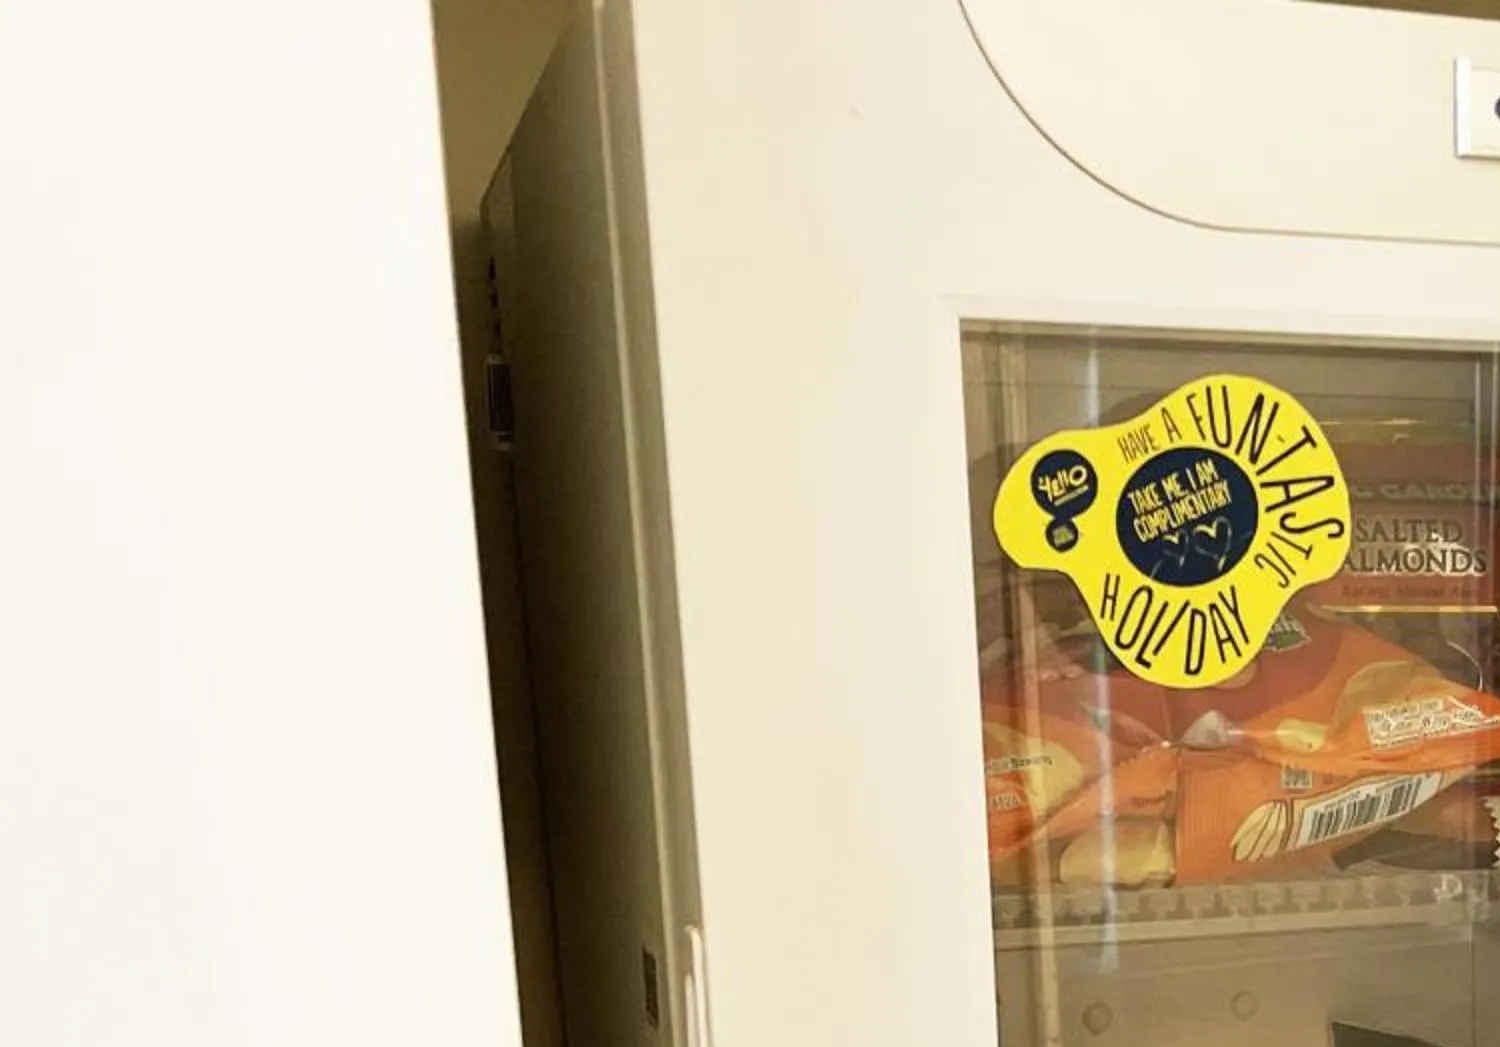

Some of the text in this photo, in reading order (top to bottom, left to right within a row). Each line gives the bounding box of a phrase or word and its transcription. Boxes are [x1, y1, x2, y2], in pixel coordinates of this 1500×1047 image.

[1117, 424, 1161, 464] HAVE
[1161, 407, 1183, 443] A
[1127, 482, 1163, 515] TAKE
[1185, 467, 1197, 492] I
[1196, 458, 1219, 487] AM
[1133, 480, 1232, 542] COMPLIMENTARY
[1355, 518, 1464, 543] SALTED
[1343, 549, 1488, 574] ALMONDS
[1101, 574, 1250, 675] HOLIDAY
